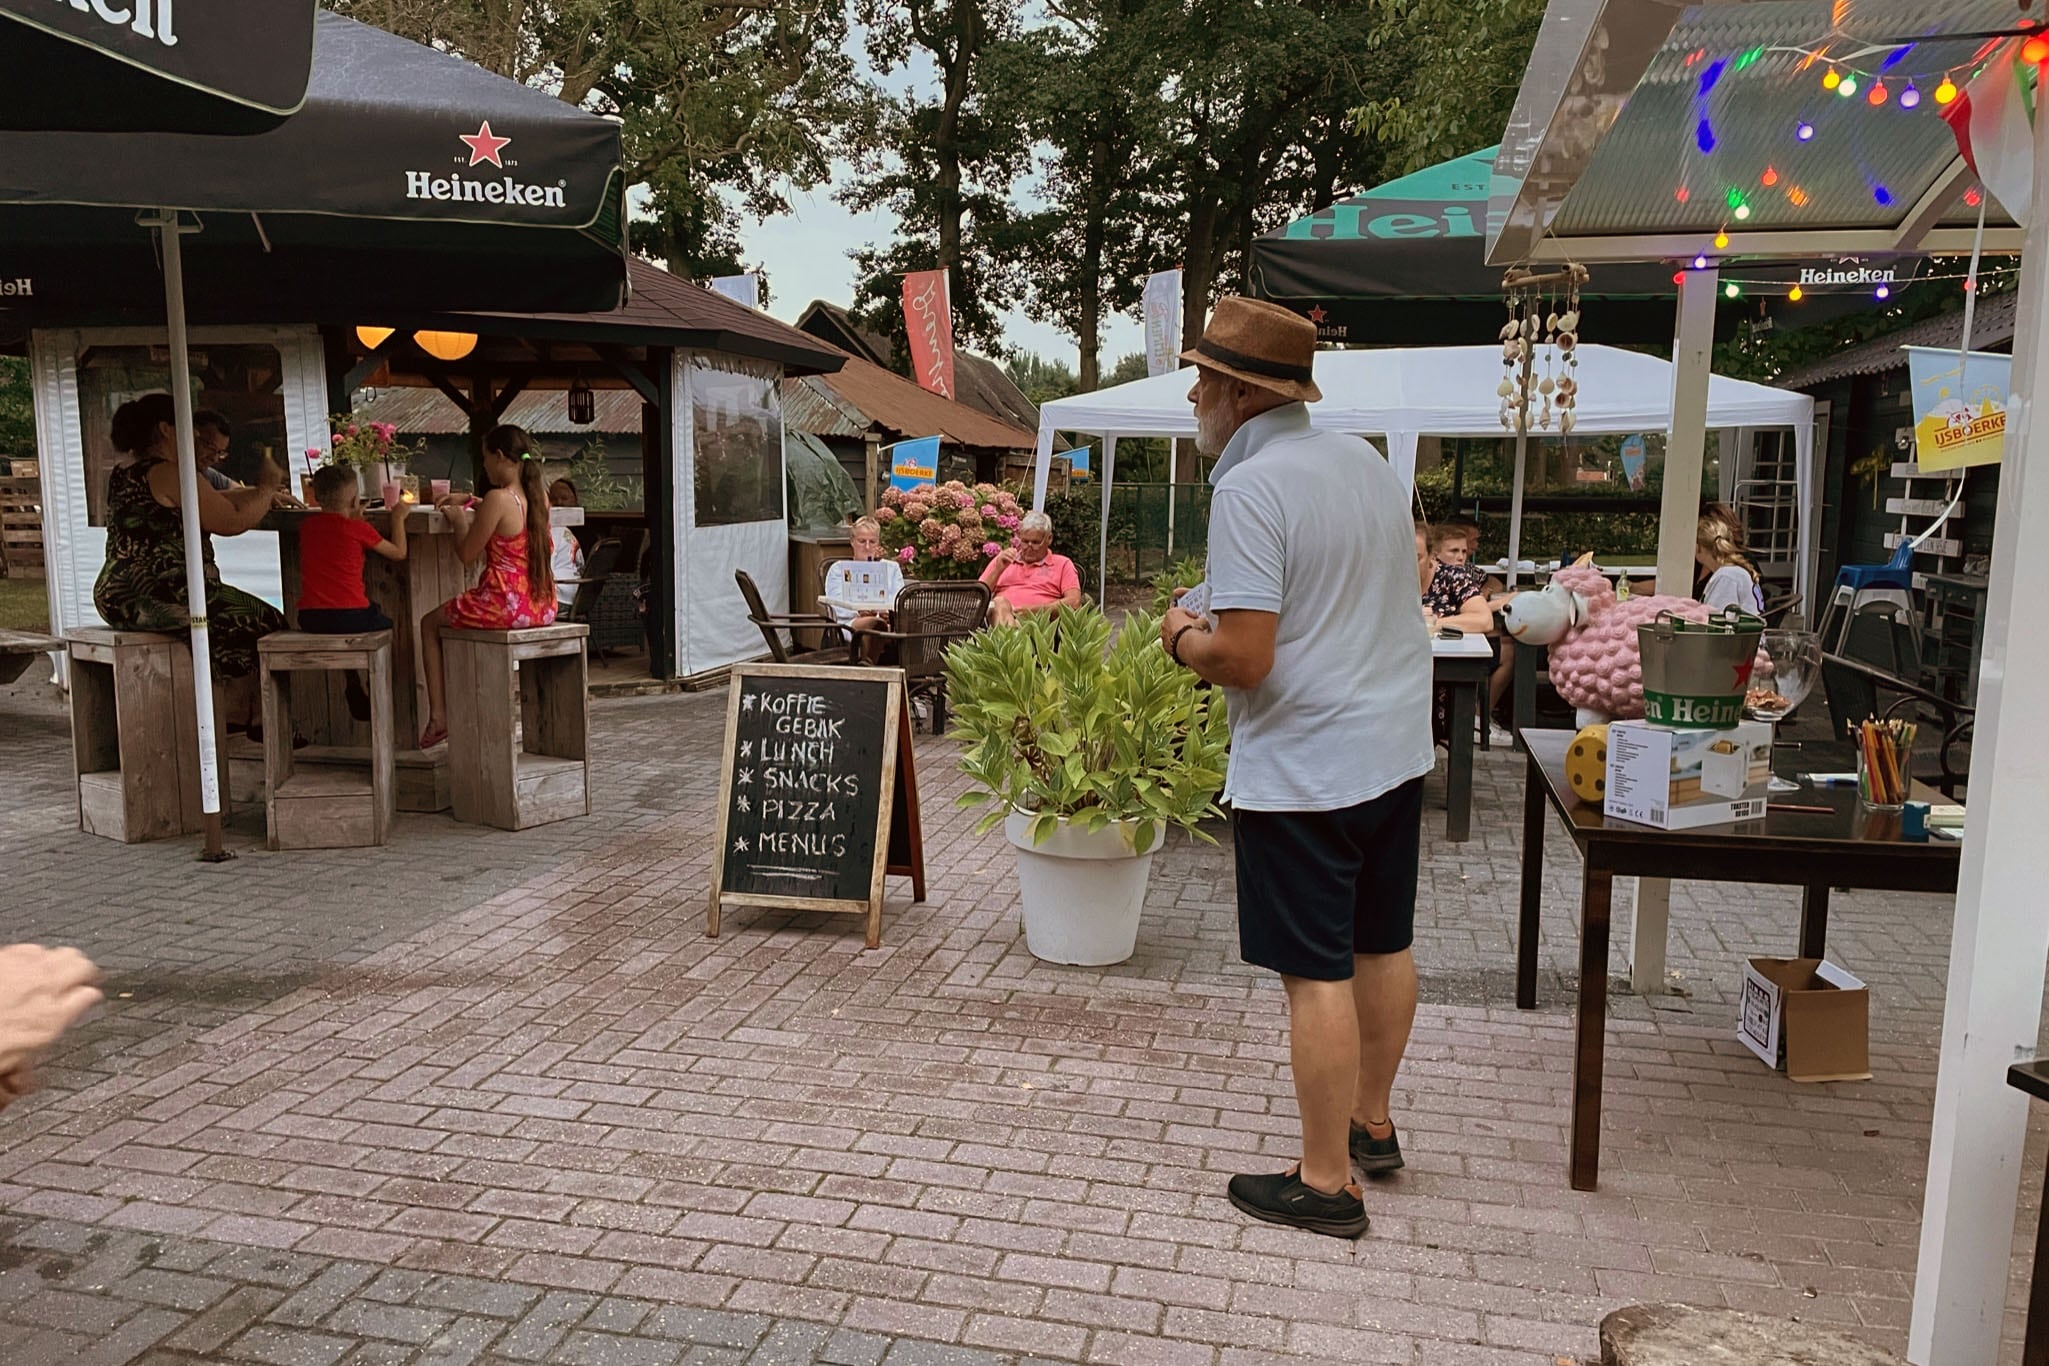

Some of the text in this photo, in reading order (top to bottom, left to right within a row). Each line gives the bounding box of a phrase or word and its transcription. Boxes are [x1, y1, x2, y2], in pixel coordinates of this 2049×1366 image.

[405, 171, 567, 208] Heineken
[1799, 267, 1896, 285] Heineken
[760, 692, 827, 715] KOFFIE
[775, 715, 846, 740] GEBAK
[760, 737, 834, 766] LUNCH
[763, 767, 859, 797] SNACKS
[762, 799, 836, 821] PIZZA
[758, 832, 846, 857] MENUS
